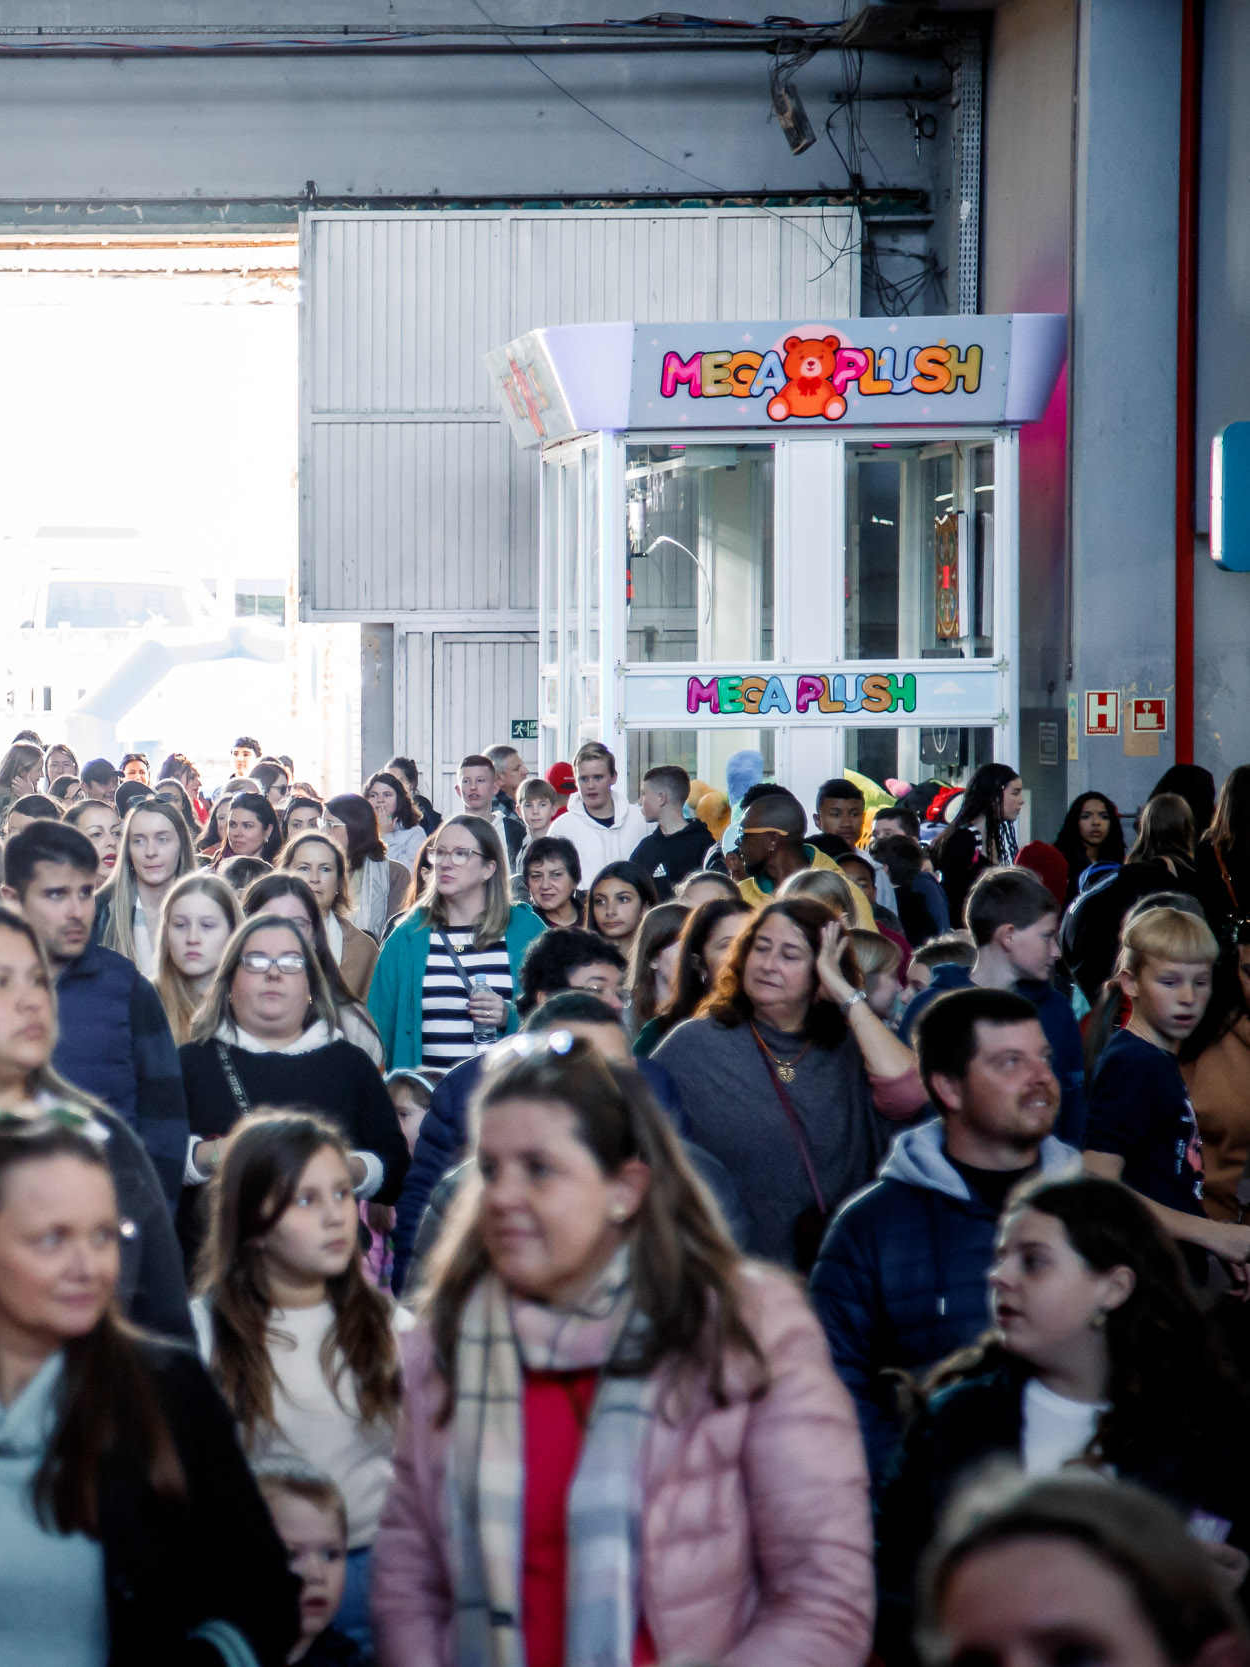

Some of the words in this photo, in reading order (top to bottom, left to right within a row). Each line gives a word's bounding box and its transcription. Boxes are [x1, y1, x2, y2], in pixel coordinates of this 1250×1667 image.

[660, 350, 788, 399] MEGA
[833, 344, 984, 396] PLUSH
[686, 675, 792, 714] MEGA
[796, 673, 917, 713] PLUSH
[1089, 694, 1116, 727] H
